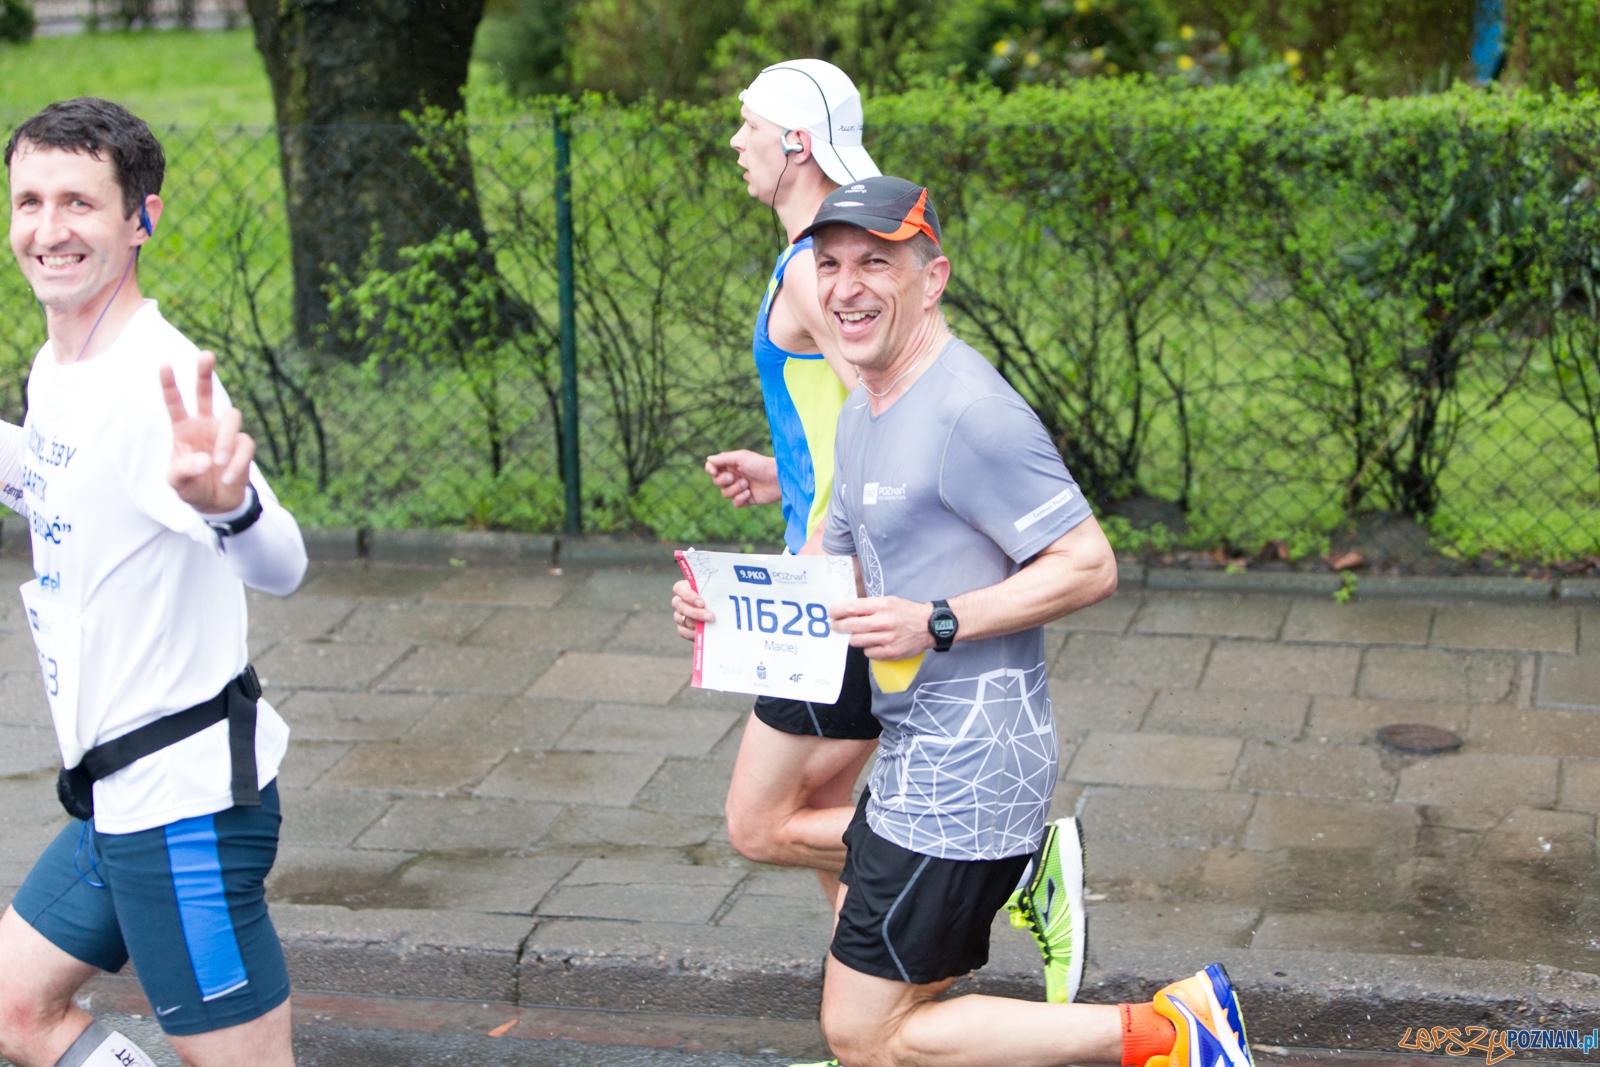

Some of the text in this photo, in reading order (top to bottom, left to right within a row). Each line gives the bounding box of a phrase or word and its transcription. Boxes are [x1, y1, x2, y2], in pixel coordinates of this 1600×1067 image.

[739, 569, 767, 581] 9.PKO
[728, 595, 831, 638] 11628
[764, 640, 798, 655] Maciej
[788, 673, 804, 683] 4F
